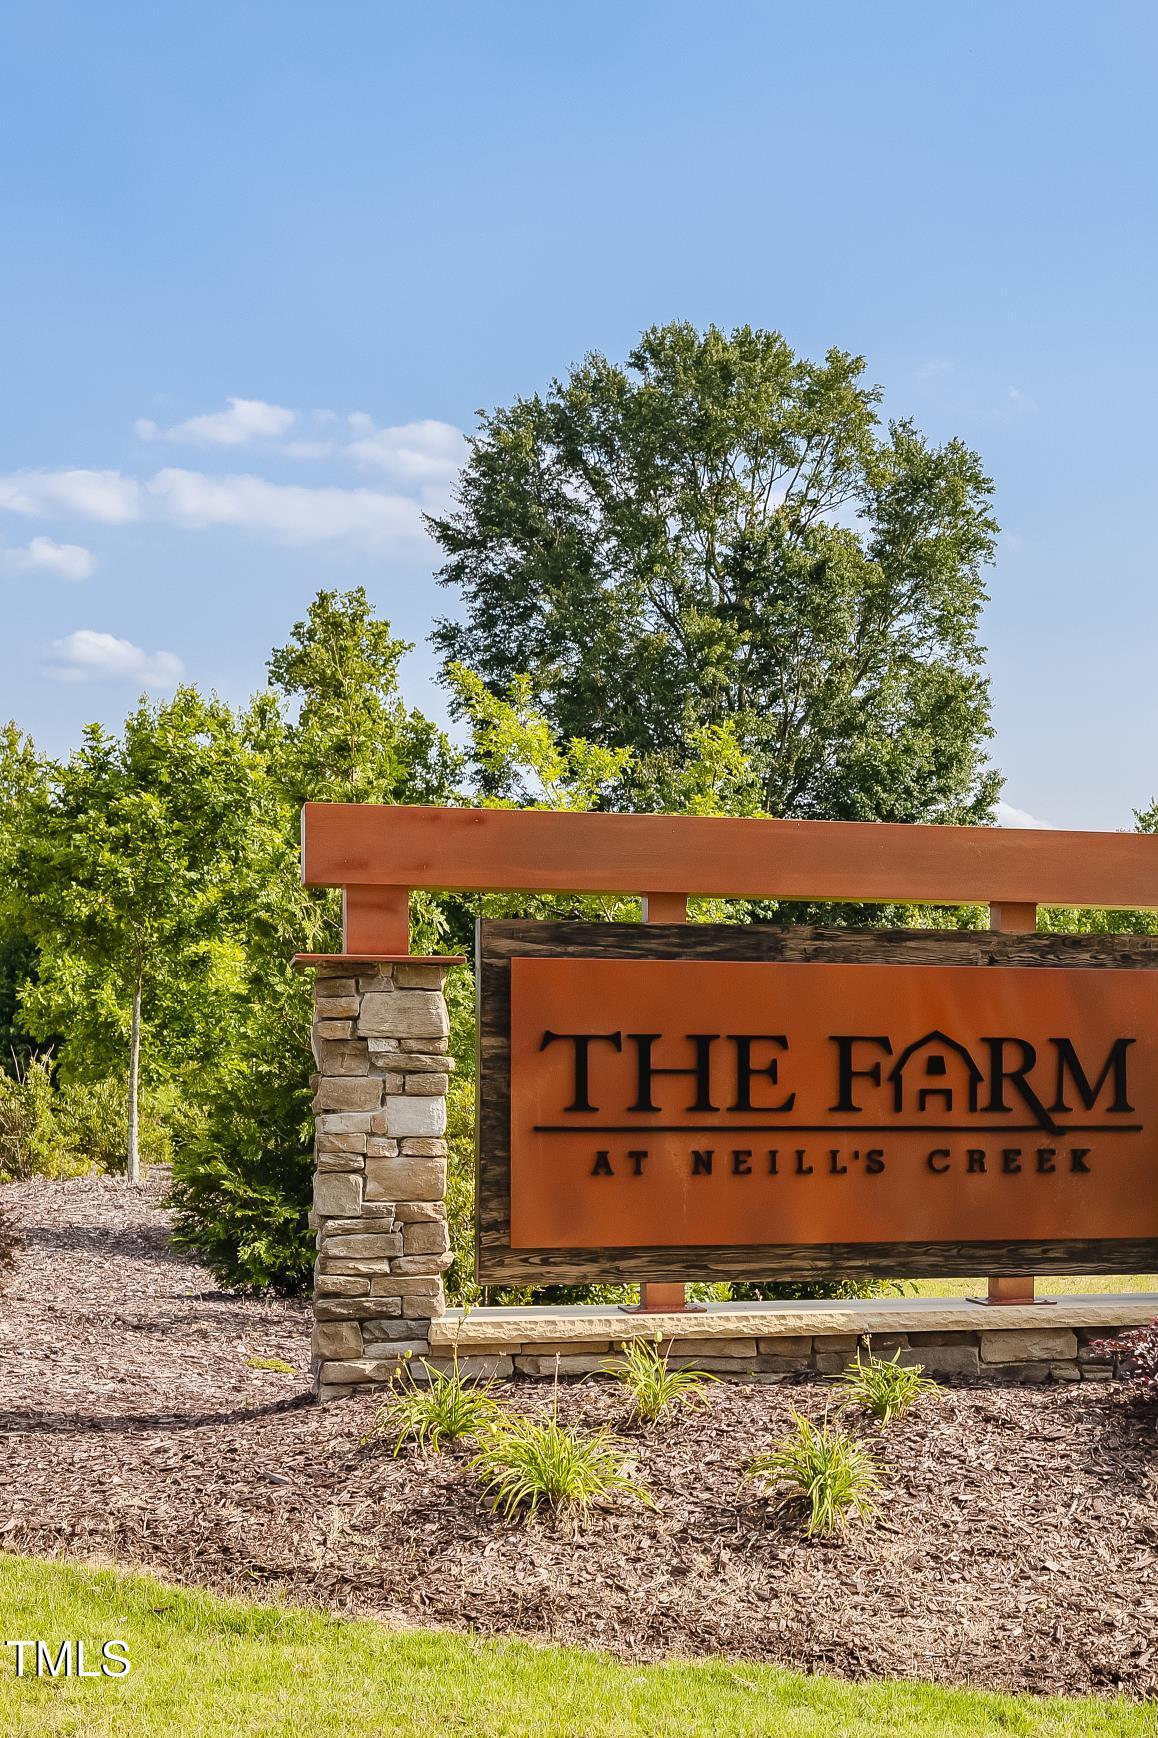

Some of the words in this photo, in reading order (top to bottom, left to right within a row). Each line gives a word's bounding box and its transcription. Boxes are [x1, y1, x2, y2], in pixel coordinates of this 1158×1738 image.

[539, 1030, 797, 1114] THE
[828, 1030, 1137, 1135] FARM
[590, 1150, 649, 1176] AT
[691, 1149, 887, 1175] NEILL'S
[927, 1148, 1093, 1174] CREEK
